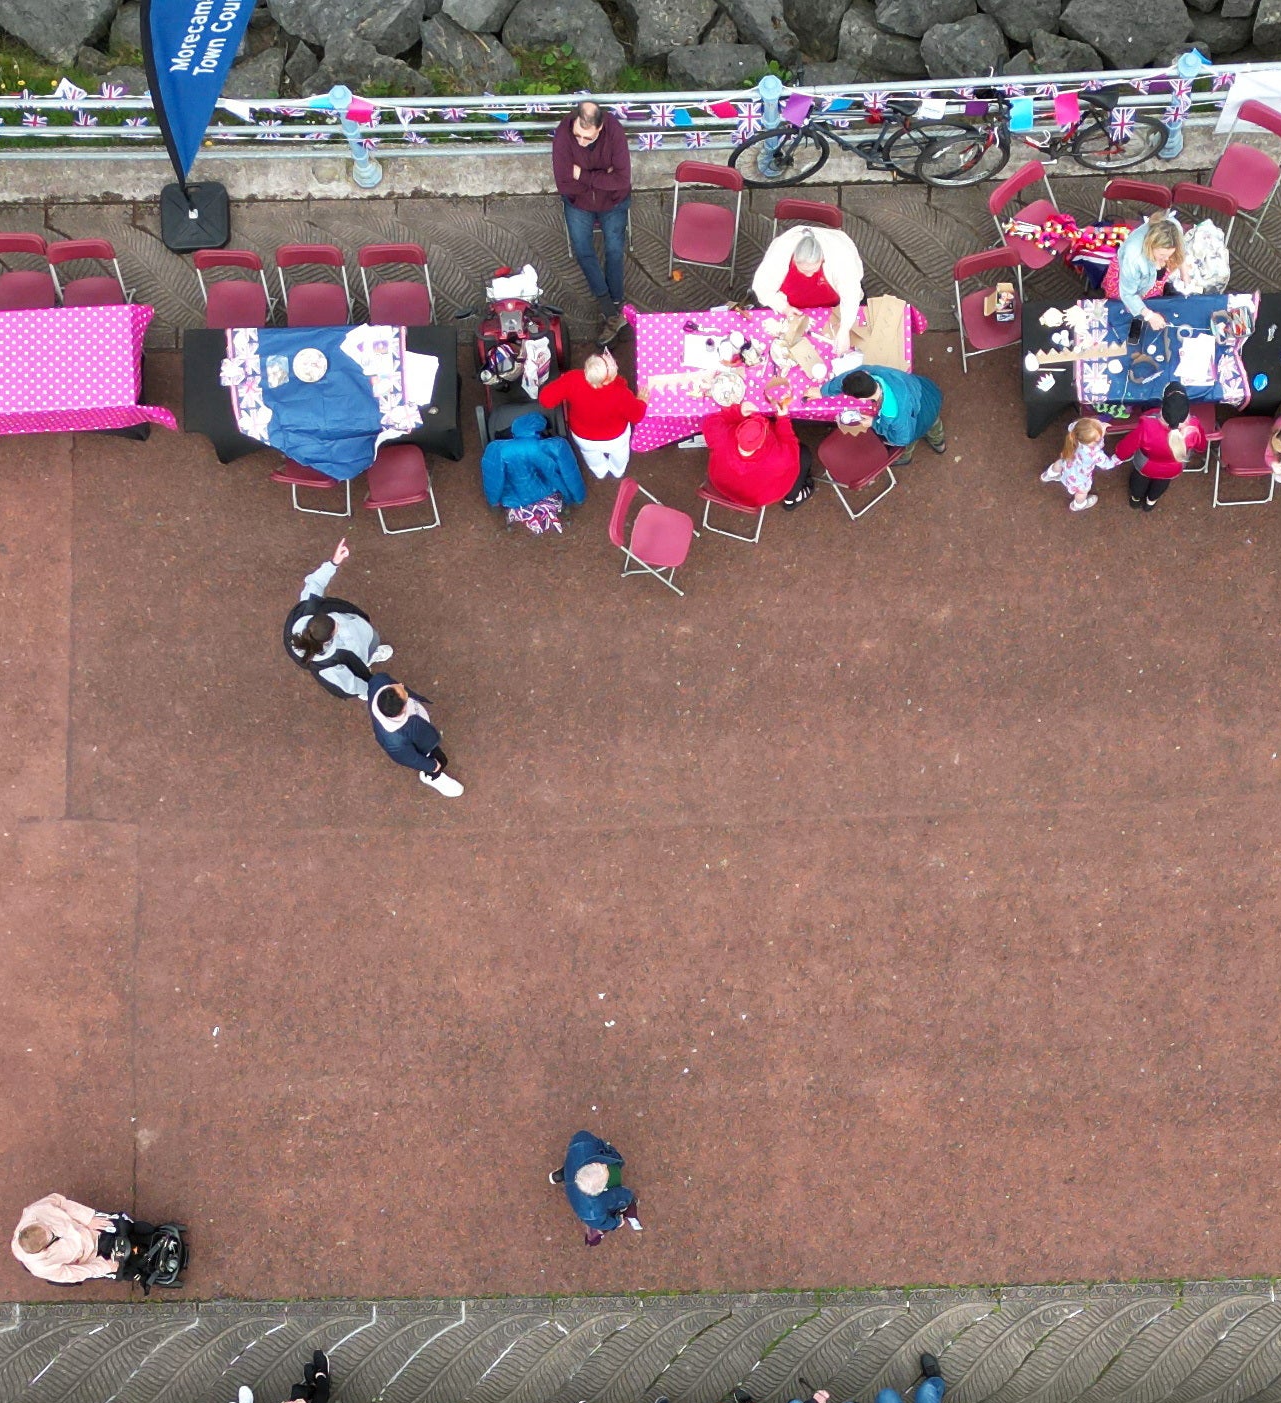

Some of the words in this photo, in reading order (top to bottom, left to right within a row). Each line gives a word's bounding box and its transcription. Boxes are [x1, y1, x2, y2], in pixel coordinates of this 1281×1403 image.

[169, 0, 214, 73] Morecam
[192, 38, 227, 76] Town
[210, 0, 242, 33] Cou
